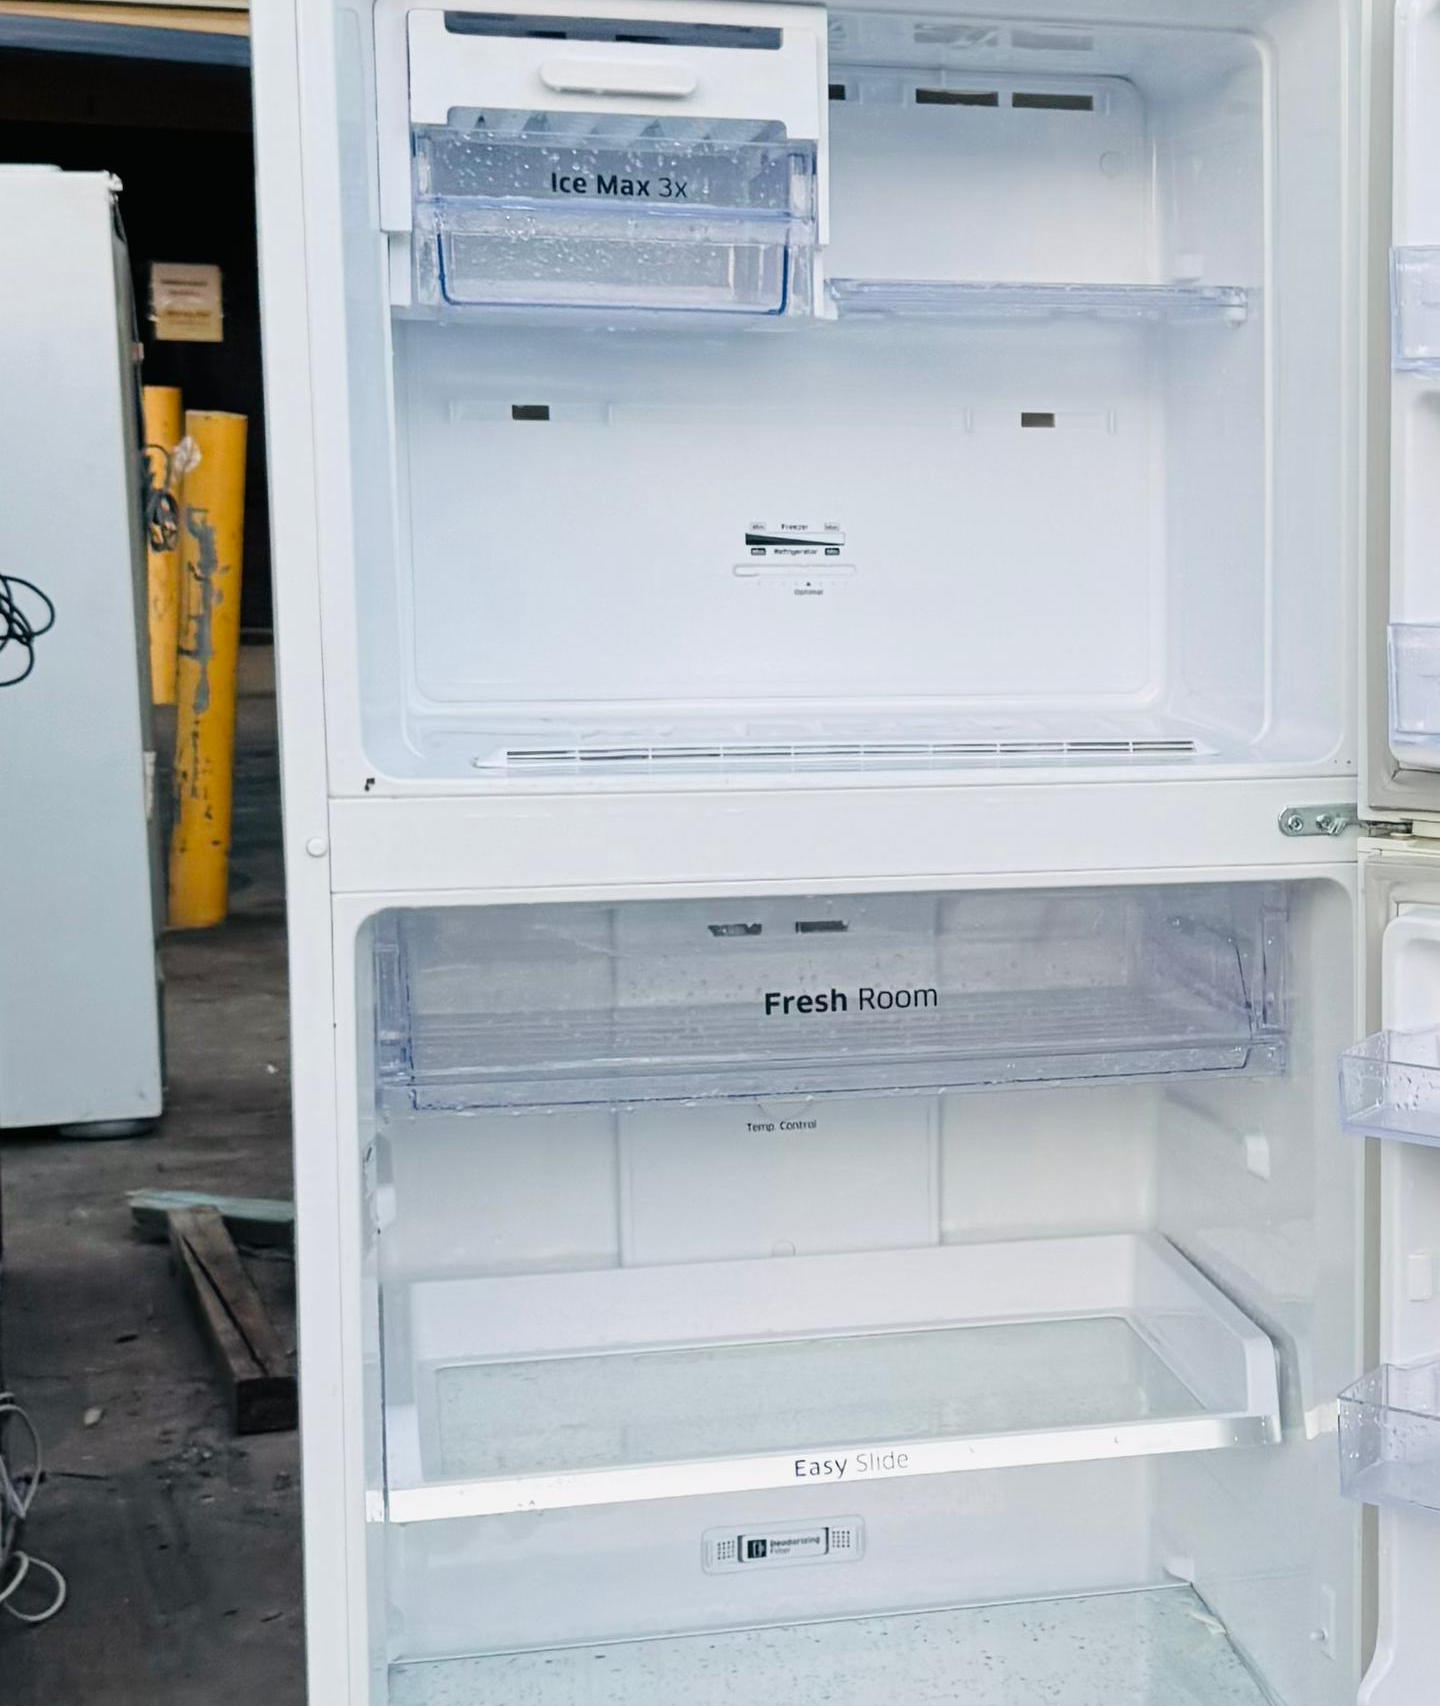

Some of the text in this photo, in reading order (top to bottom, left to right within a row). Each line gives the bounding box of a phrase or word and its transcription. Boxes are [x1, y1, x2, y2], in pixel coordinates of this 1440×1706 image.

[551, 172, 687, 198] Ice Max 3x
[765, 987, 938, 1015] Fresh Room
[780, 1119, 817, 1130] Control
[795, 1451, 909, 1479] Easy Slide
[770, 1537, 820, 1547] Deodorizing
